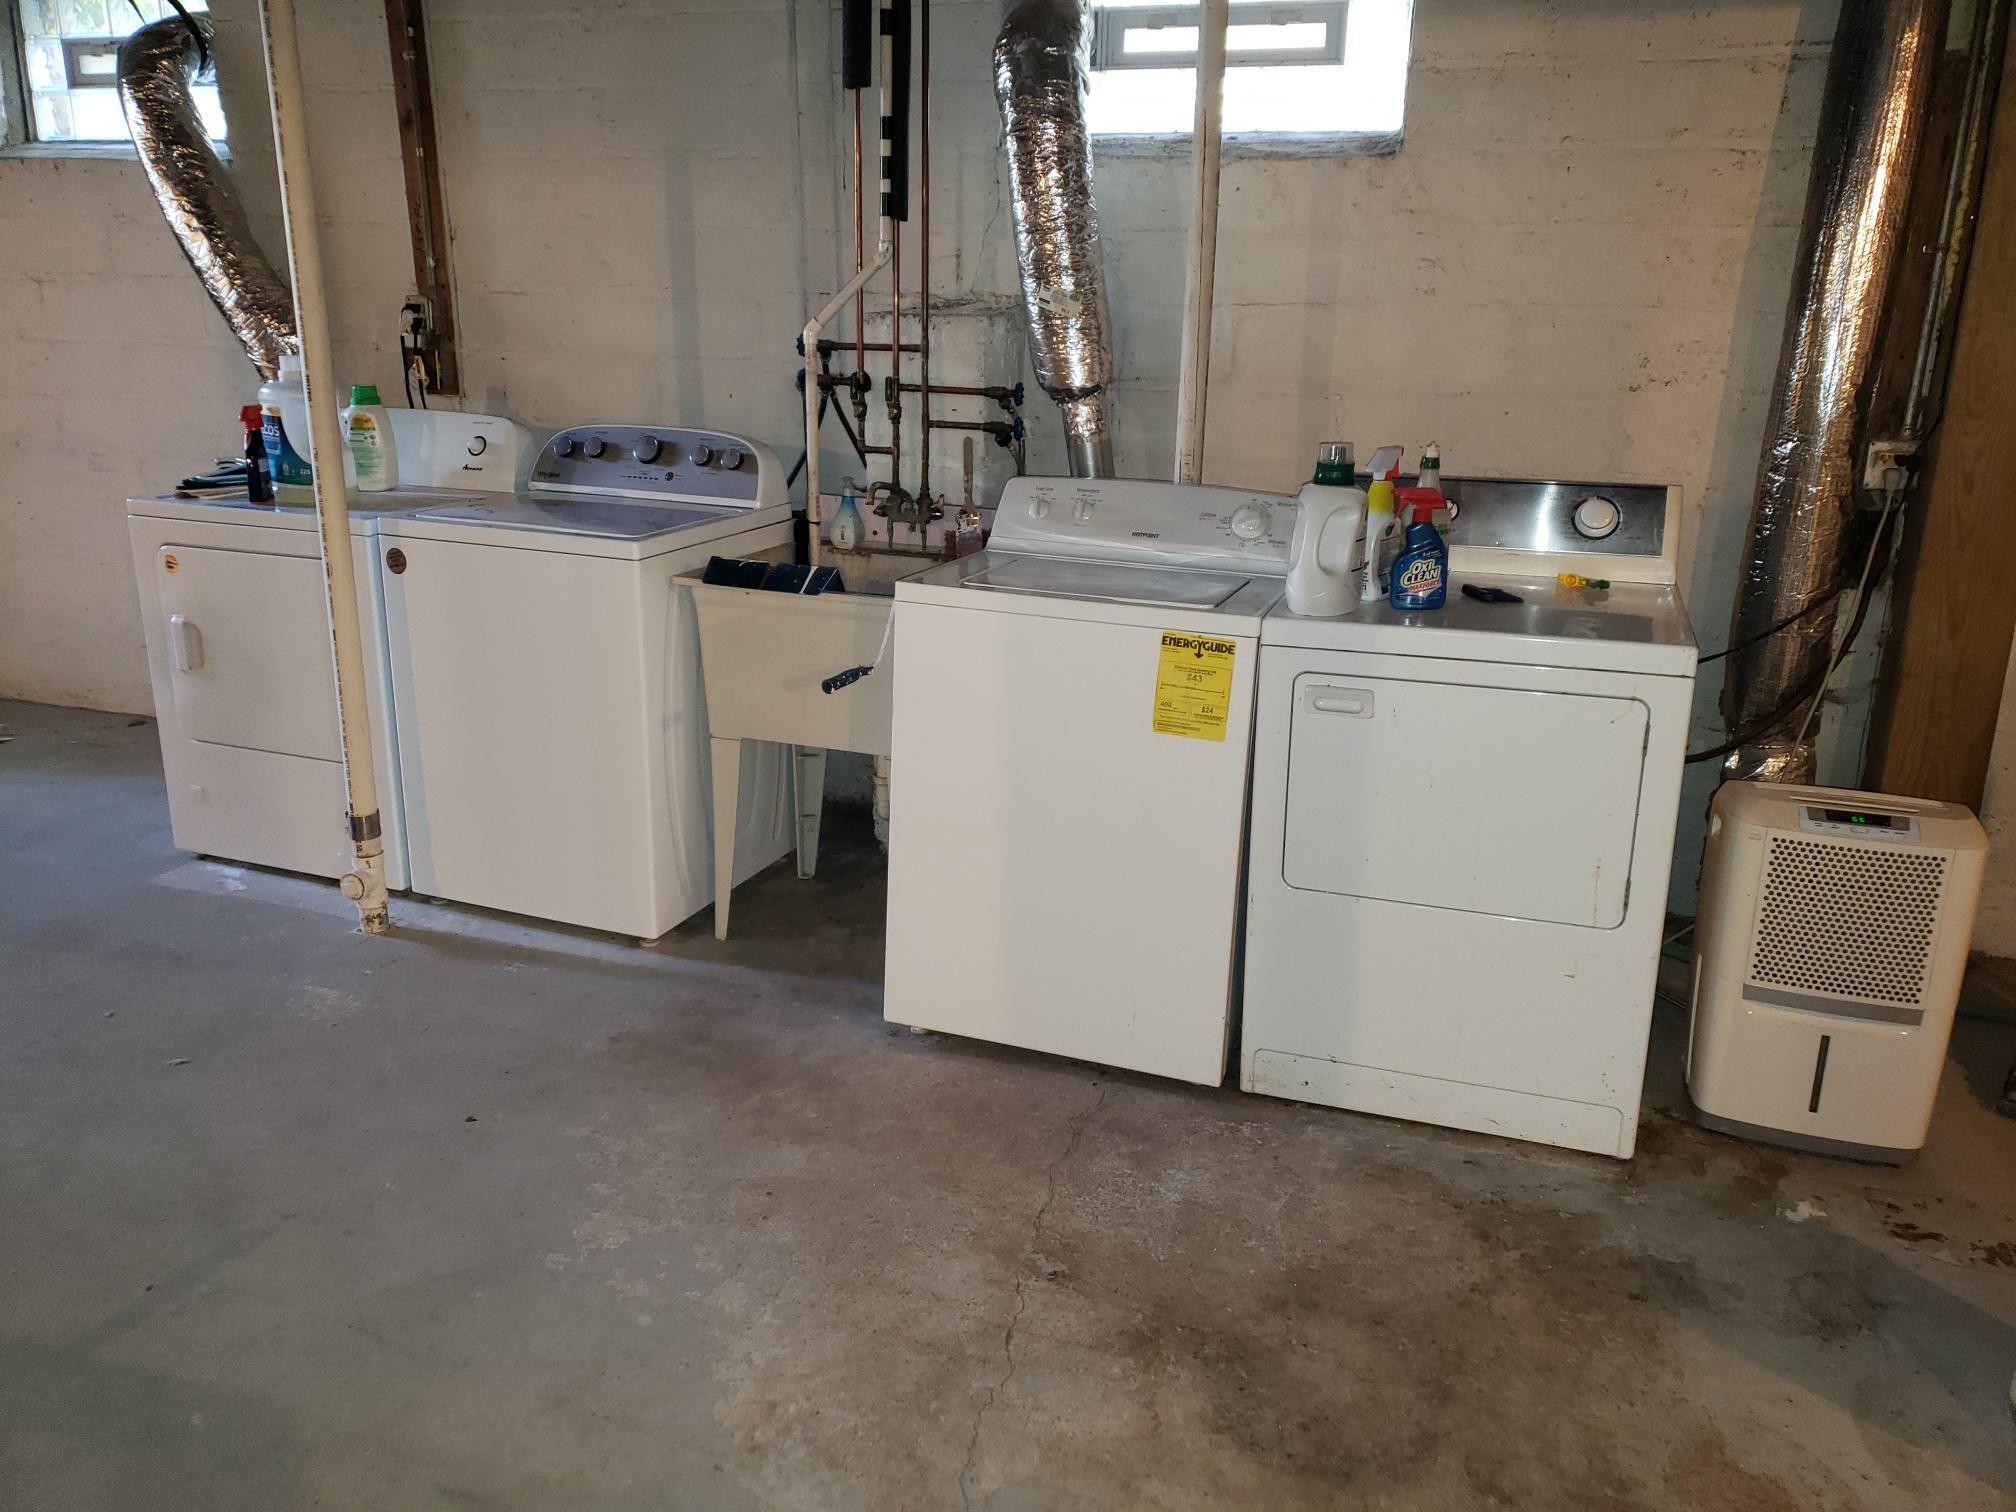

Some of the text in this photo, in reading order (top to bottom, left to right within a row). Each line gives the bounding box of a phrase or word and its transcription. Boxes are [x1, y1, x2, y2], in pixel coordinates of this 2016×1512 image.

[1402, 568, 1440, 586] CLEAN
[1410, 561, 1434, 575] OXI
[1161, 635, 1236, 657] ENERGYGUIDE
